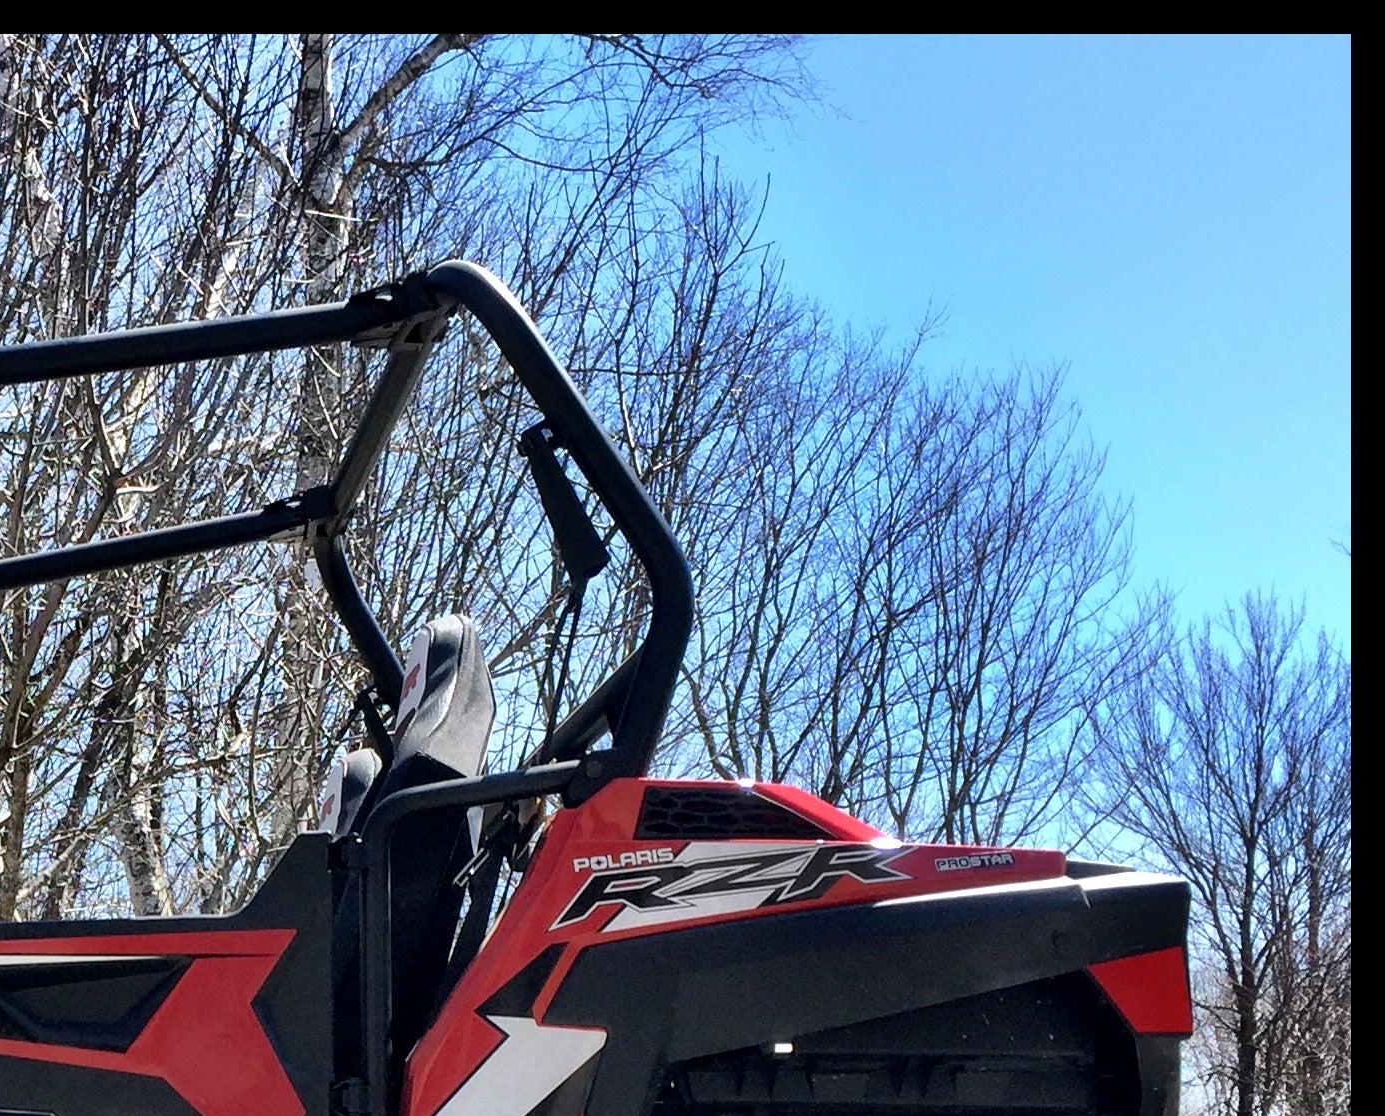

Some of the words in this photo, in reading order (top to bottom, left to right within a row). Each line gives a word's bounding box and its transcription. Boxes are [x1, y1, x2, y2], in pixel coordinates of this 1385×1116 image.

[573, 847, 674, 872] POLARIS
[936, 853, 1014, 871] PROSTAR
[547, 845, 917, 931] RZR
